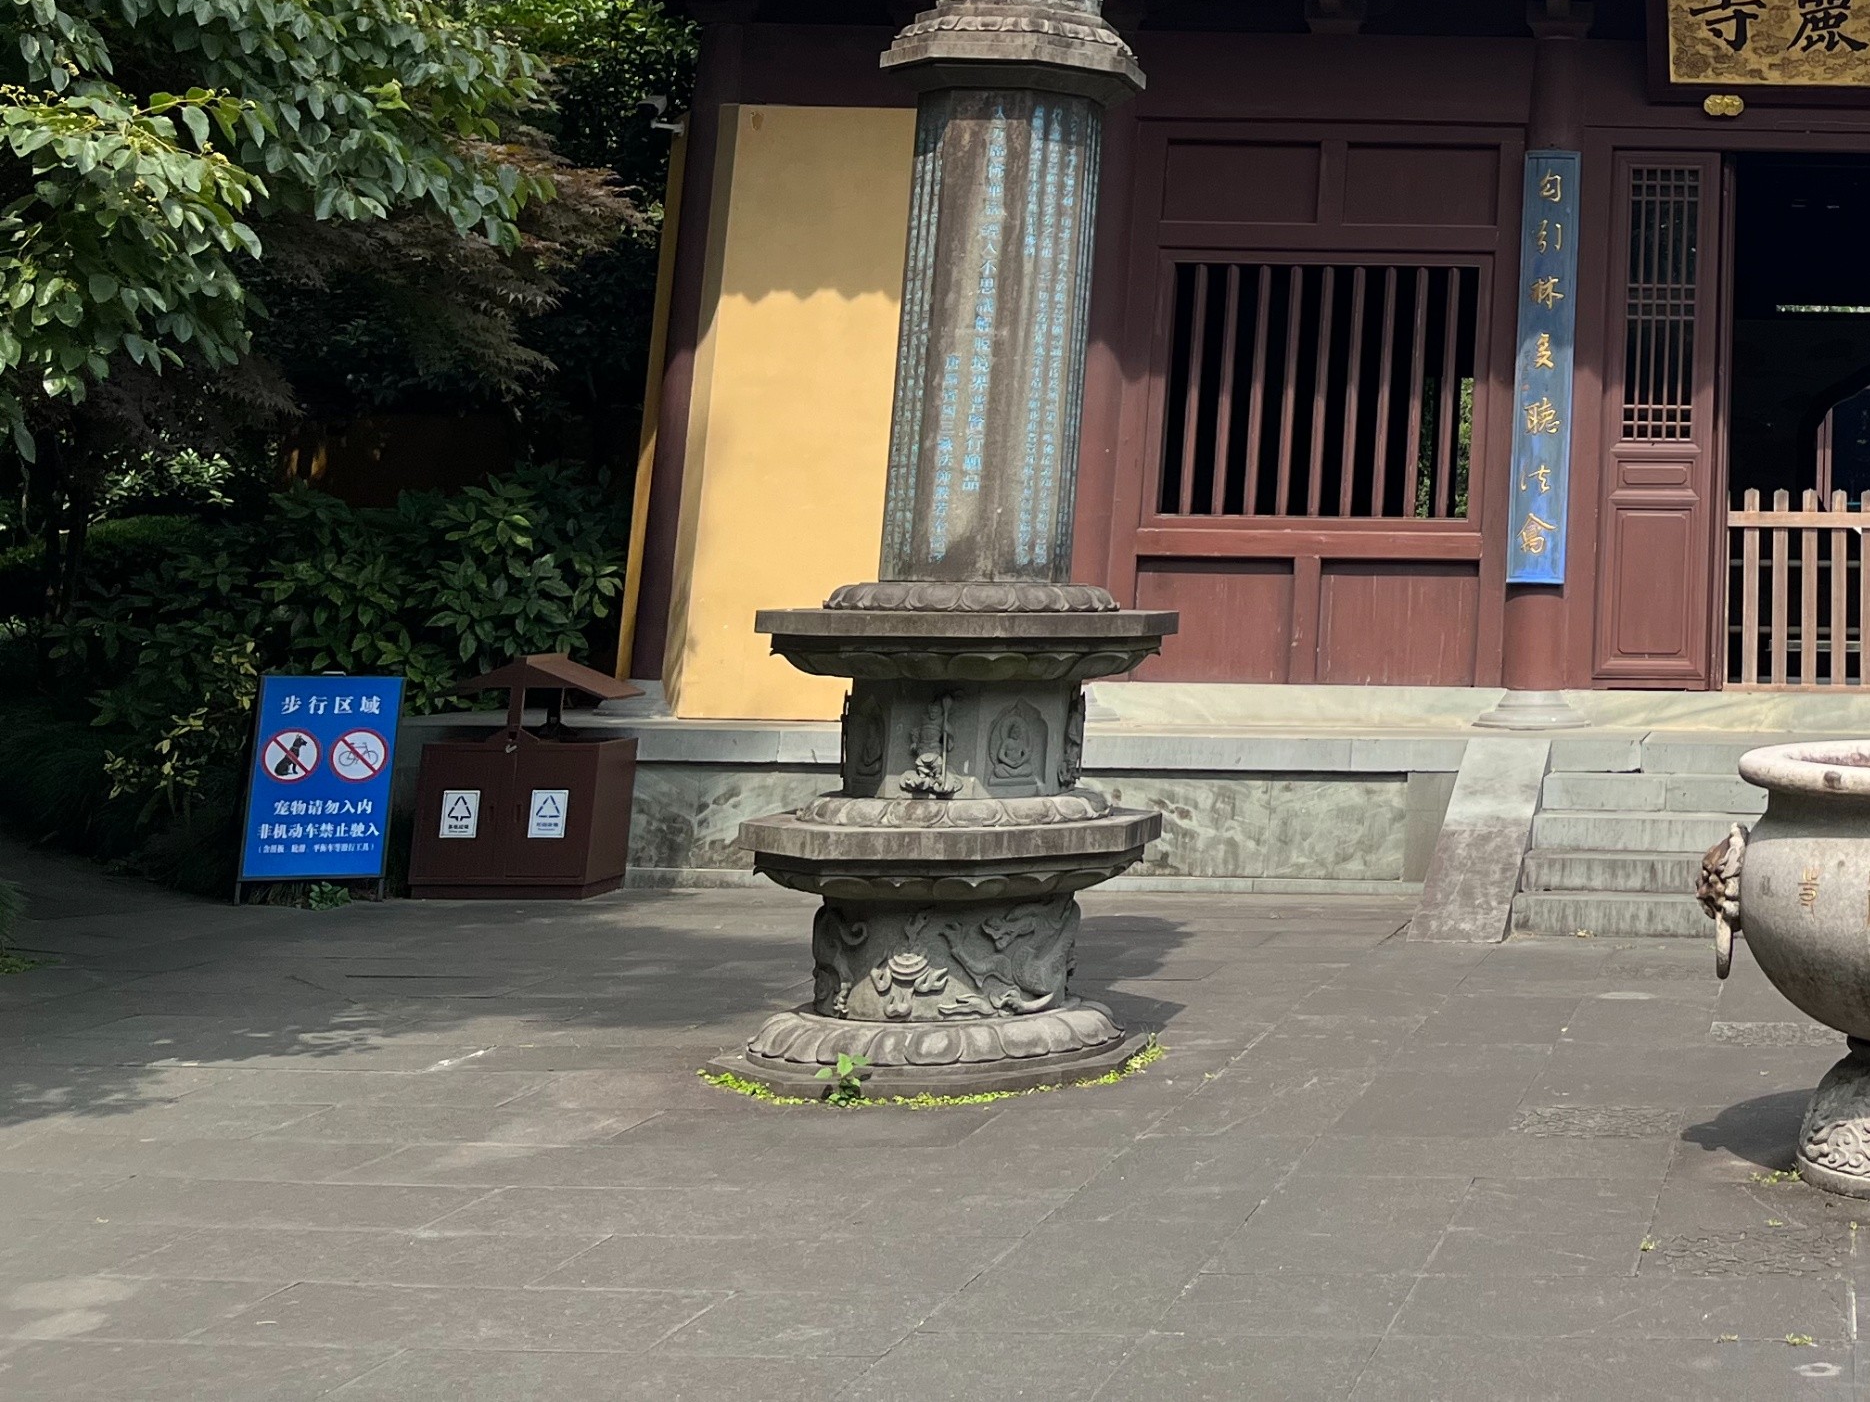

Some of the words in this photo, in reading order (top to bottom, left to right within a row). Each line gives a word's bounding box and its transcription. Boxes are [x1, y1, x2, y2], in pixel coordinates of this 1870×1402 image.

[281, 695, 381, 715] 步行区域
[273, 799, 373, 815] 宠物请勿入内
[257, 822, 380, 839] 非机动车禁止驶入
